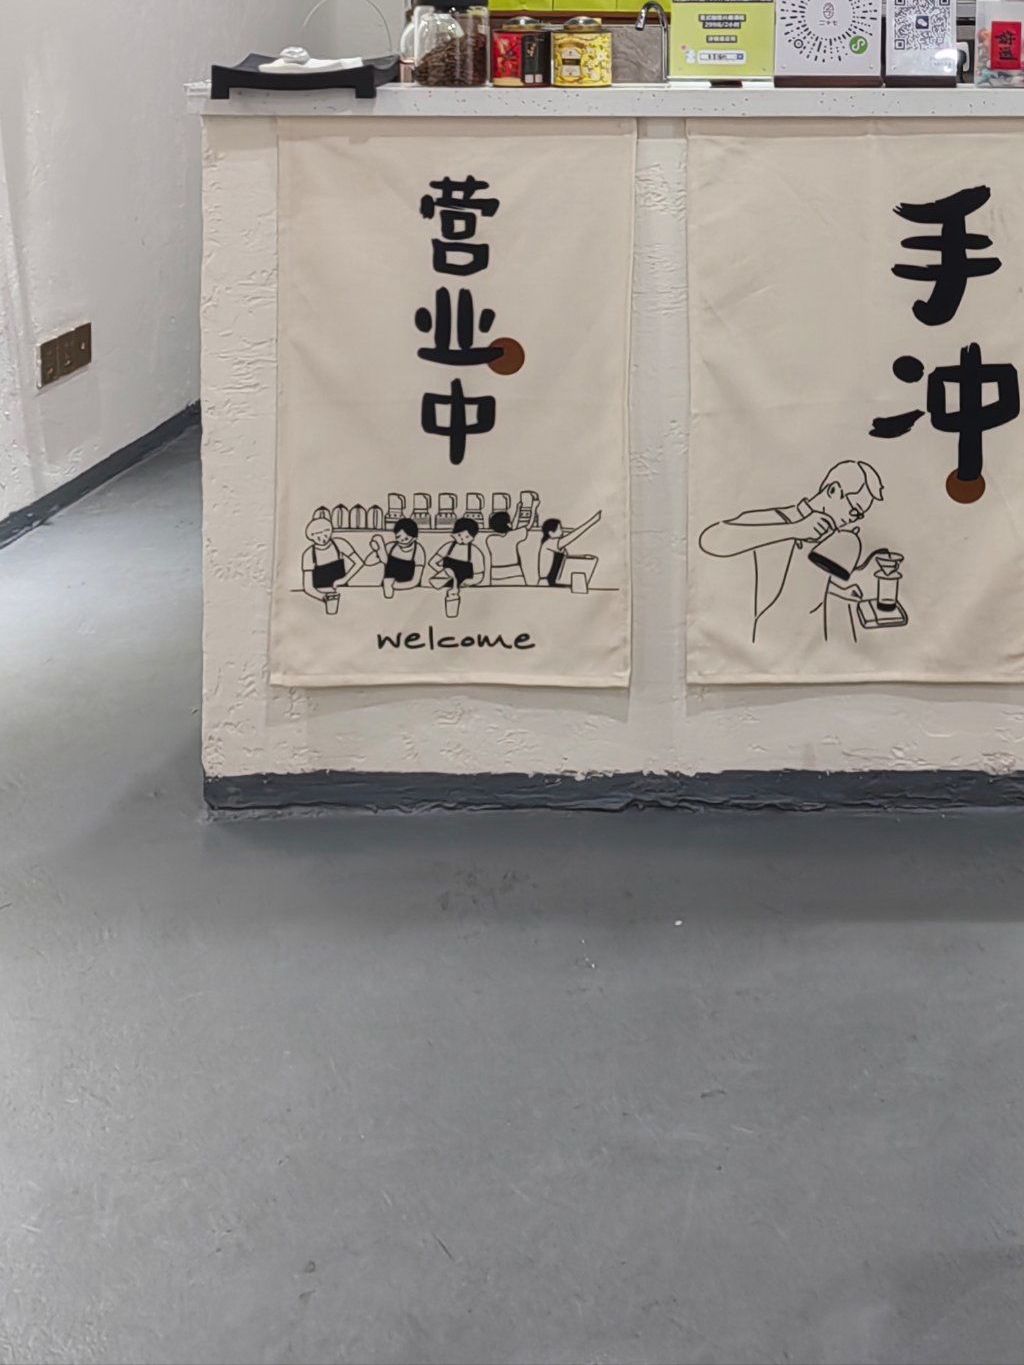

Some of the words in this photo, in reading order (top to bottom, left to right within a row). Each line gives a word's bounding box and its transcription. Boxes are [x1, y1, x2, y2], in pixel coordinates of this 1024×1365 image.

[414, 175, 504, 465] 营业中
[868, 185, 1021, 481] 手冲
[376, 625, 537, 652] welcome
